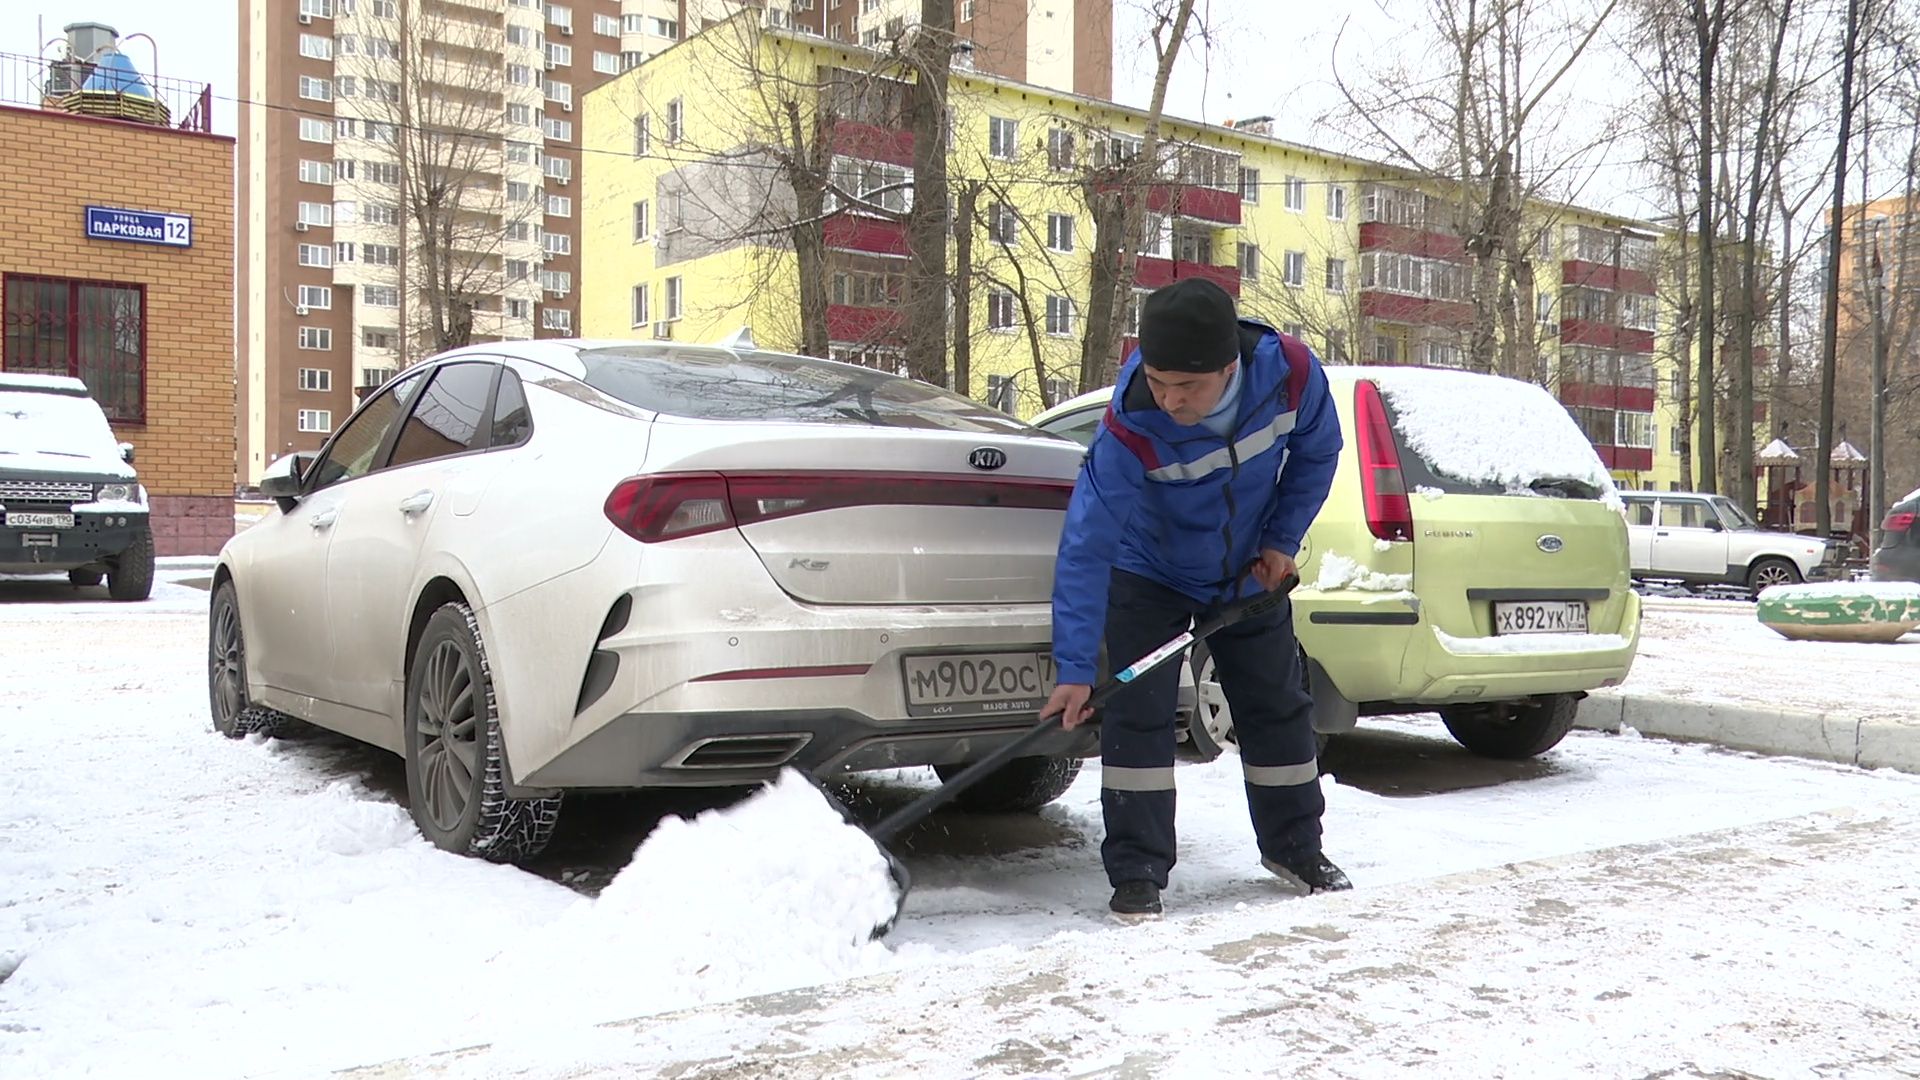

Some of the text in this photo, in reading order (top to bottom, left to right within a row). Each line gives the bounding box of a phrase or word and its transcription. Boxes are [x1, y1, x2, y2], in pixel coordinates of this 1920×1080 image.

[94, 221, 186, 240] ПАРКОВАЯ 12
[974, 451, 1001, 466] KIA
[983, 701, 1030, 711] MAJOR AUTO
